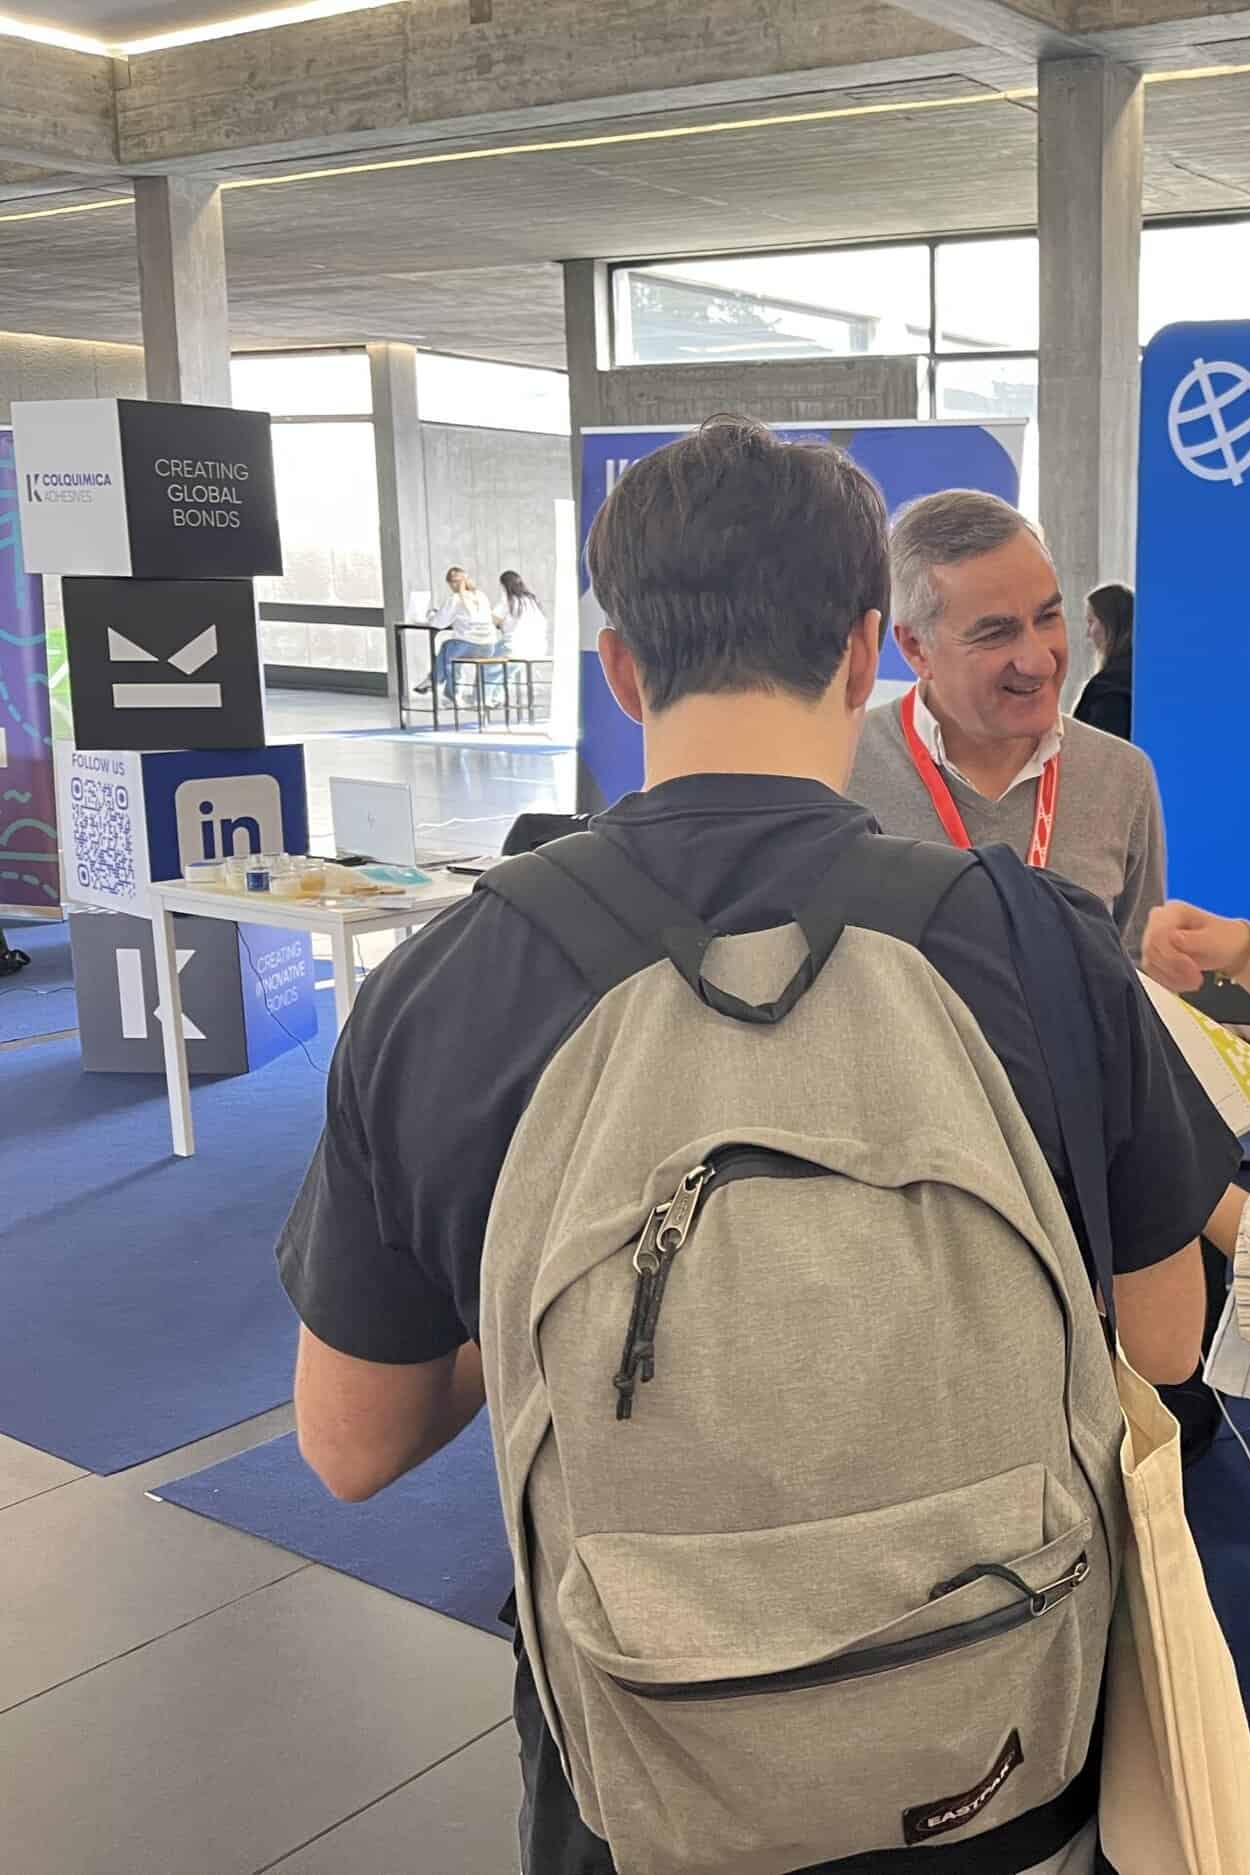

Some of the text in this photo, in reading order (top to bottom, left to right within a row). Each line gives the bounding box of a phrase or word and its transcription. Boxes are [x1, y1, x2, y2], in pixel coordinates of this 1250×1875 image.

[42, 473, 112, 487] COLQUIMICA
[154, 458, 249, 481] CREATING
[167, 484, 243, 505] GLOBAL
[172, 508, 241, 529] BONDS
[72, 753, 126, 776] FOLLOW US
[198, 800, 261, 859] in
